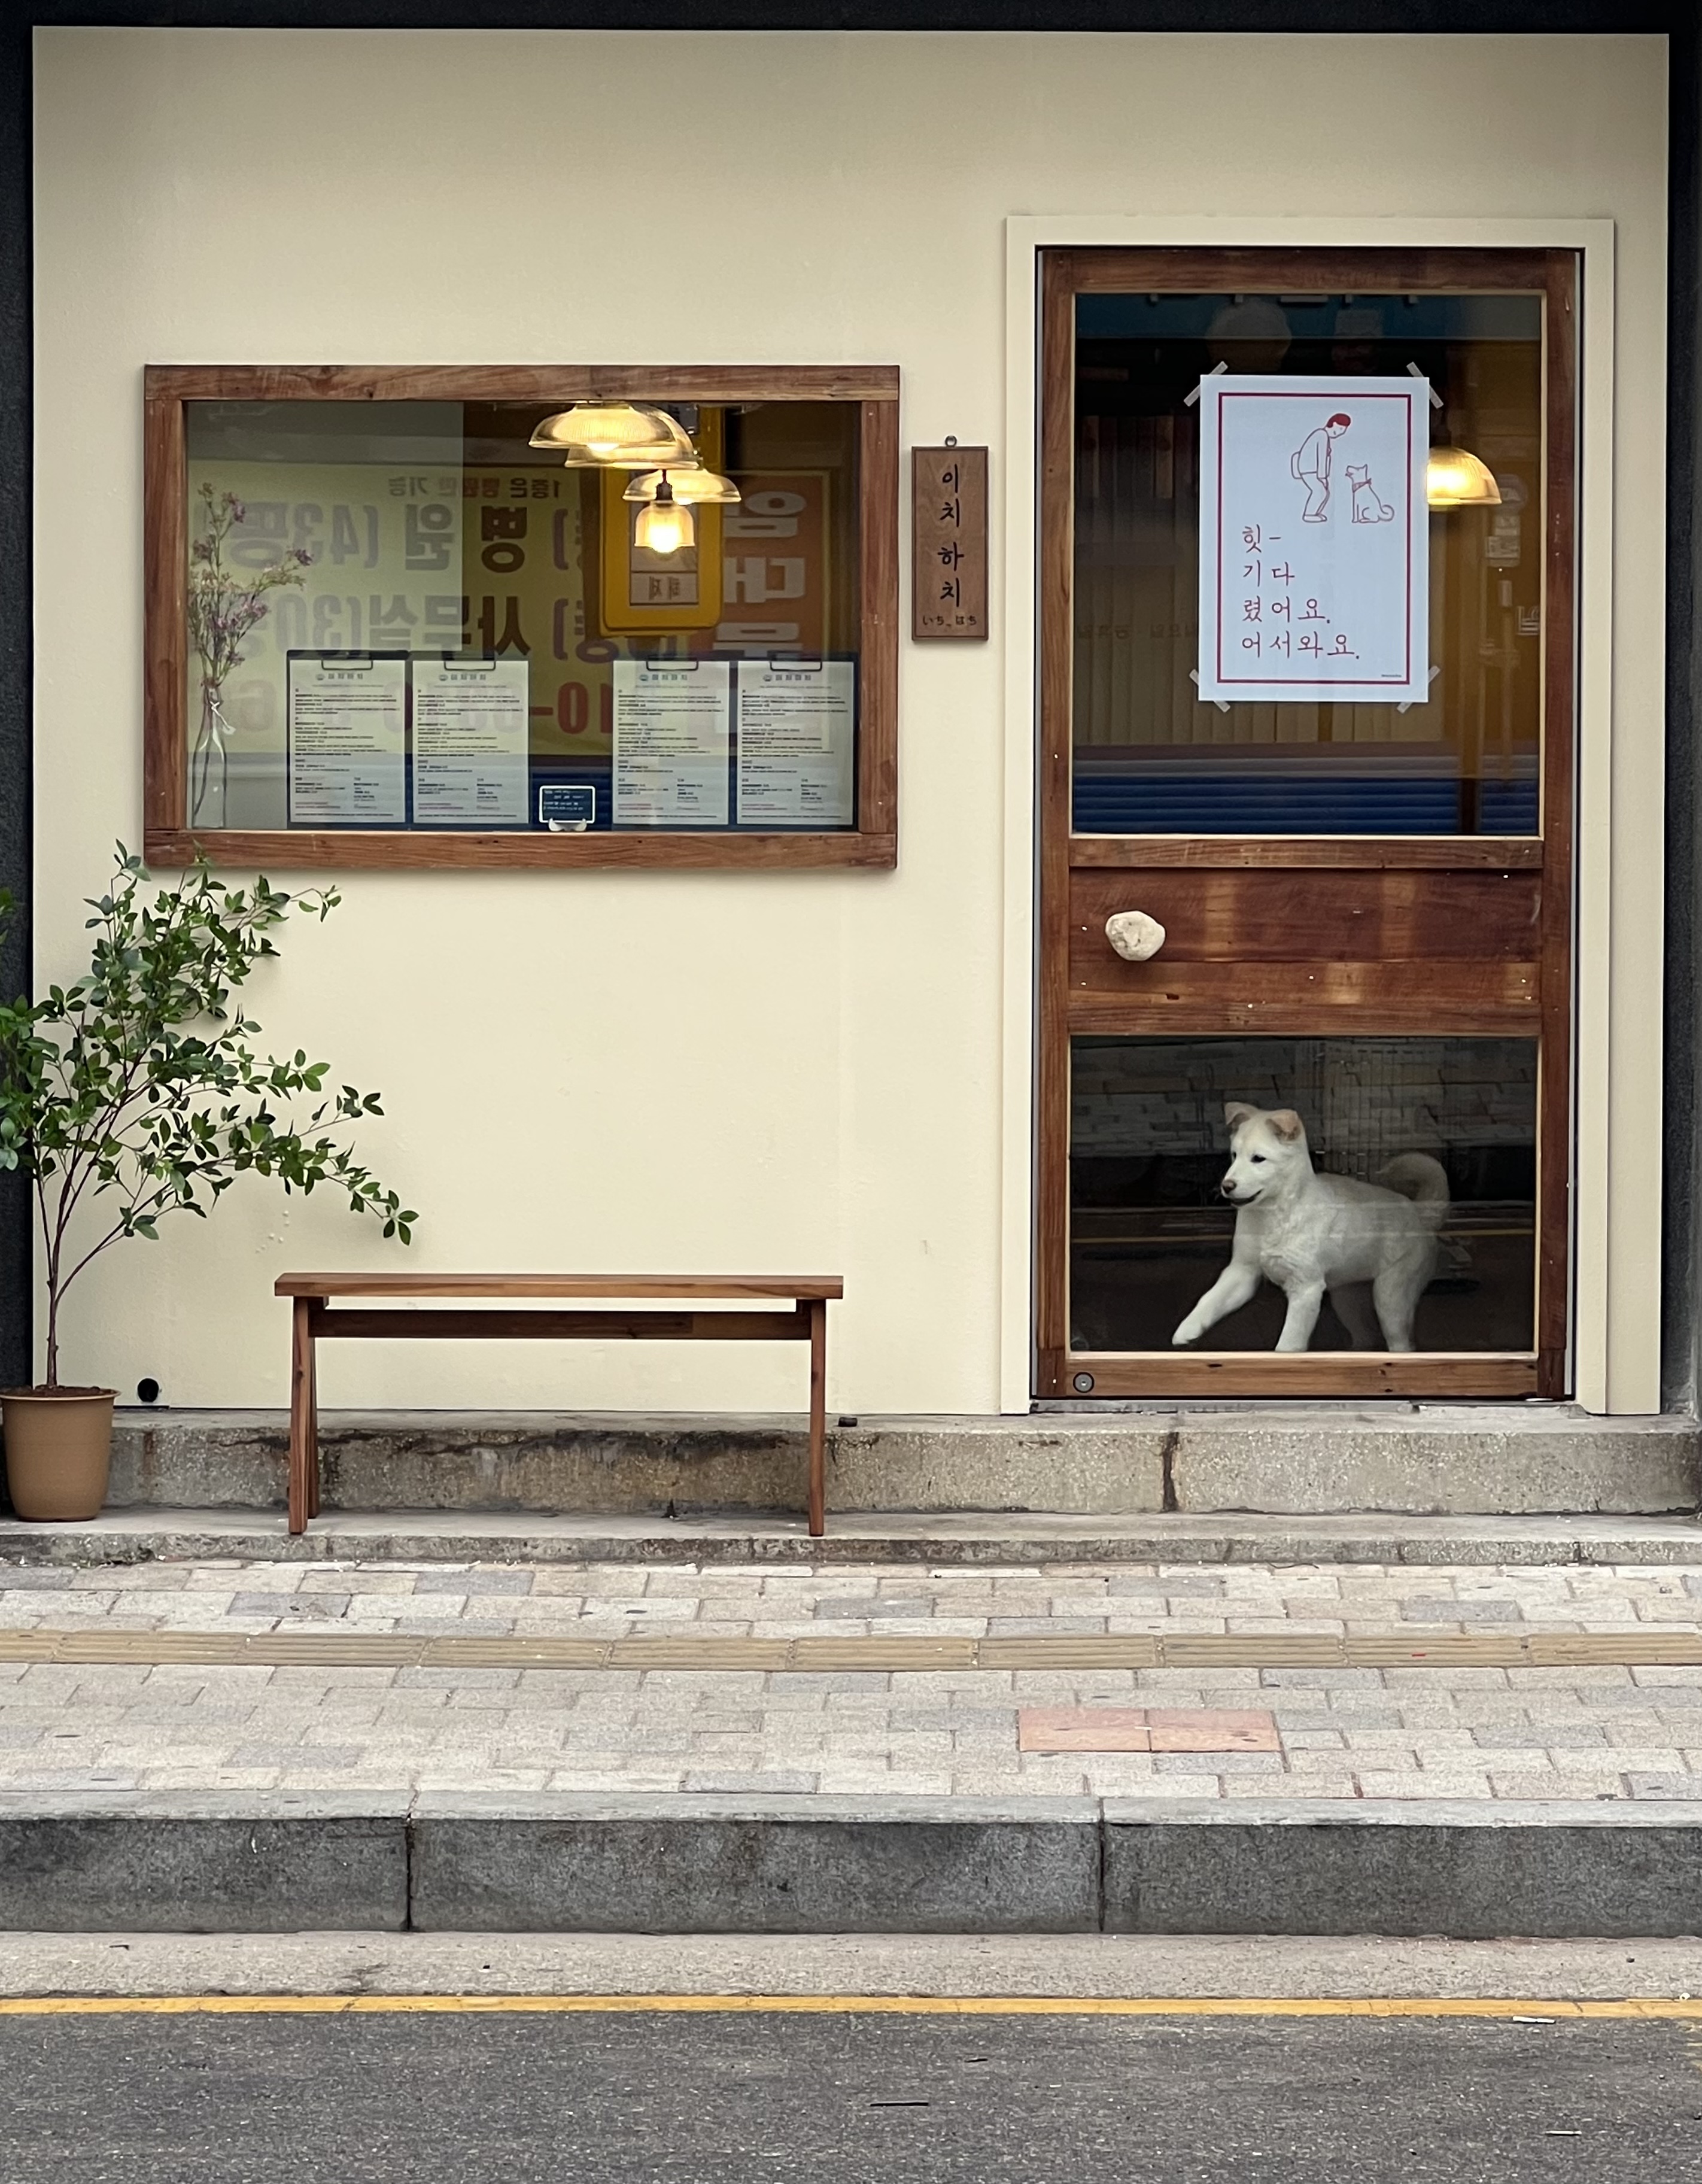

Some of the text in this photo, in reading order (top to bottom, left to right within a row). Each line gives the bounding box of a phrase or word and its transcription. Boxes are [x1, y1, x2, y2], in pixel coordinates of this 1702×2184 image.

[938, 463, 965, 607] 이치하치
[1243, 560, 1295, 587] 기다
[1242, 631, 1360, 660] 어서와요.
